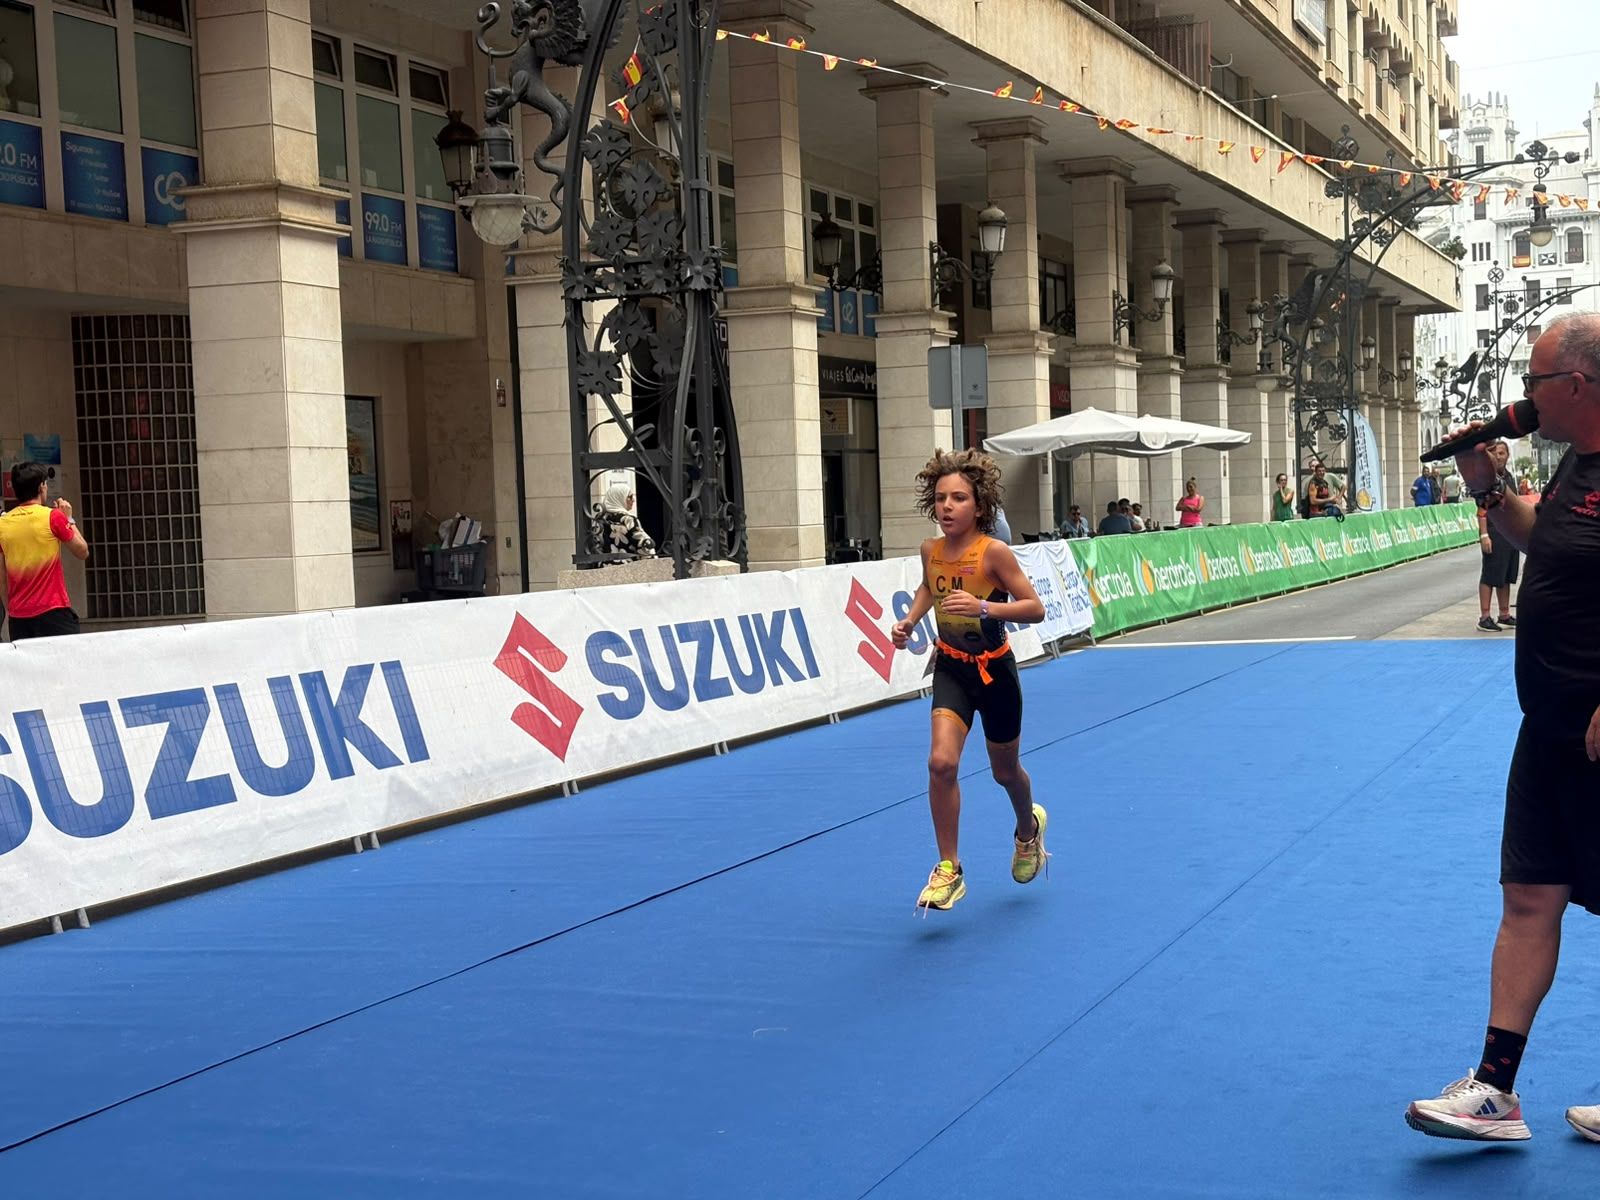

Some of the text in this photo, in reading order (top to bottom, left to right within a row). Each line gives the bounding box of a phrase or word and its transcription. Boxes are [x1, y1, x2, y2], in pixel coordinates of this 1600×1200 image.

[20, 153, 38, 169] FM
[365, 210, 389, 233] 99.0
[822, 369, 844, 383] VIAJES
[585, 607, 821, 720] SUZUKI
